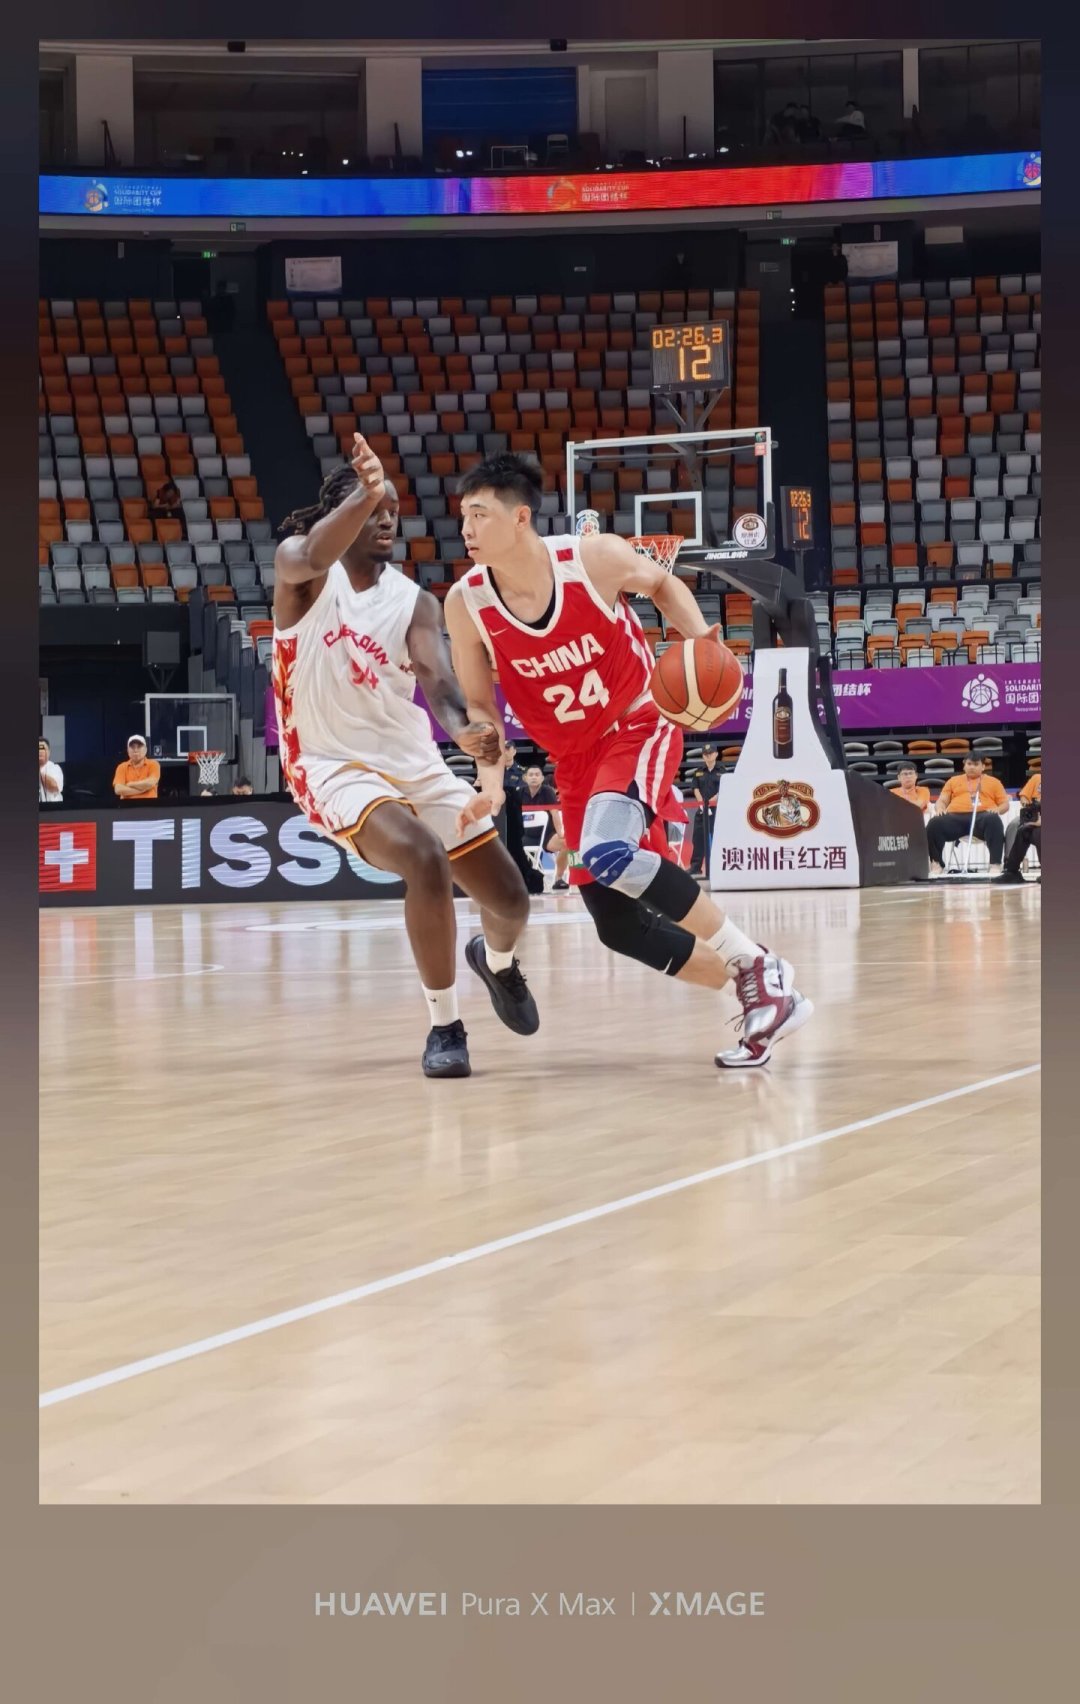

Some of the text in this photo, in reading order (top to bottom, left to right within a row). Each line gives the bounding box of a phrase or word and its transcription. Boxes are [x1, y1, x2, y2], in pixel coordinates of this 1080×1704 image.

[652, 326, 723, 349] 02:26.3
[679, 344, 711, 381] 12
[511, 633, 605, 678] CHINA
[543, 669, 610, 724] 24
[721, 846, 847, 871] 澳洲虎红酒
